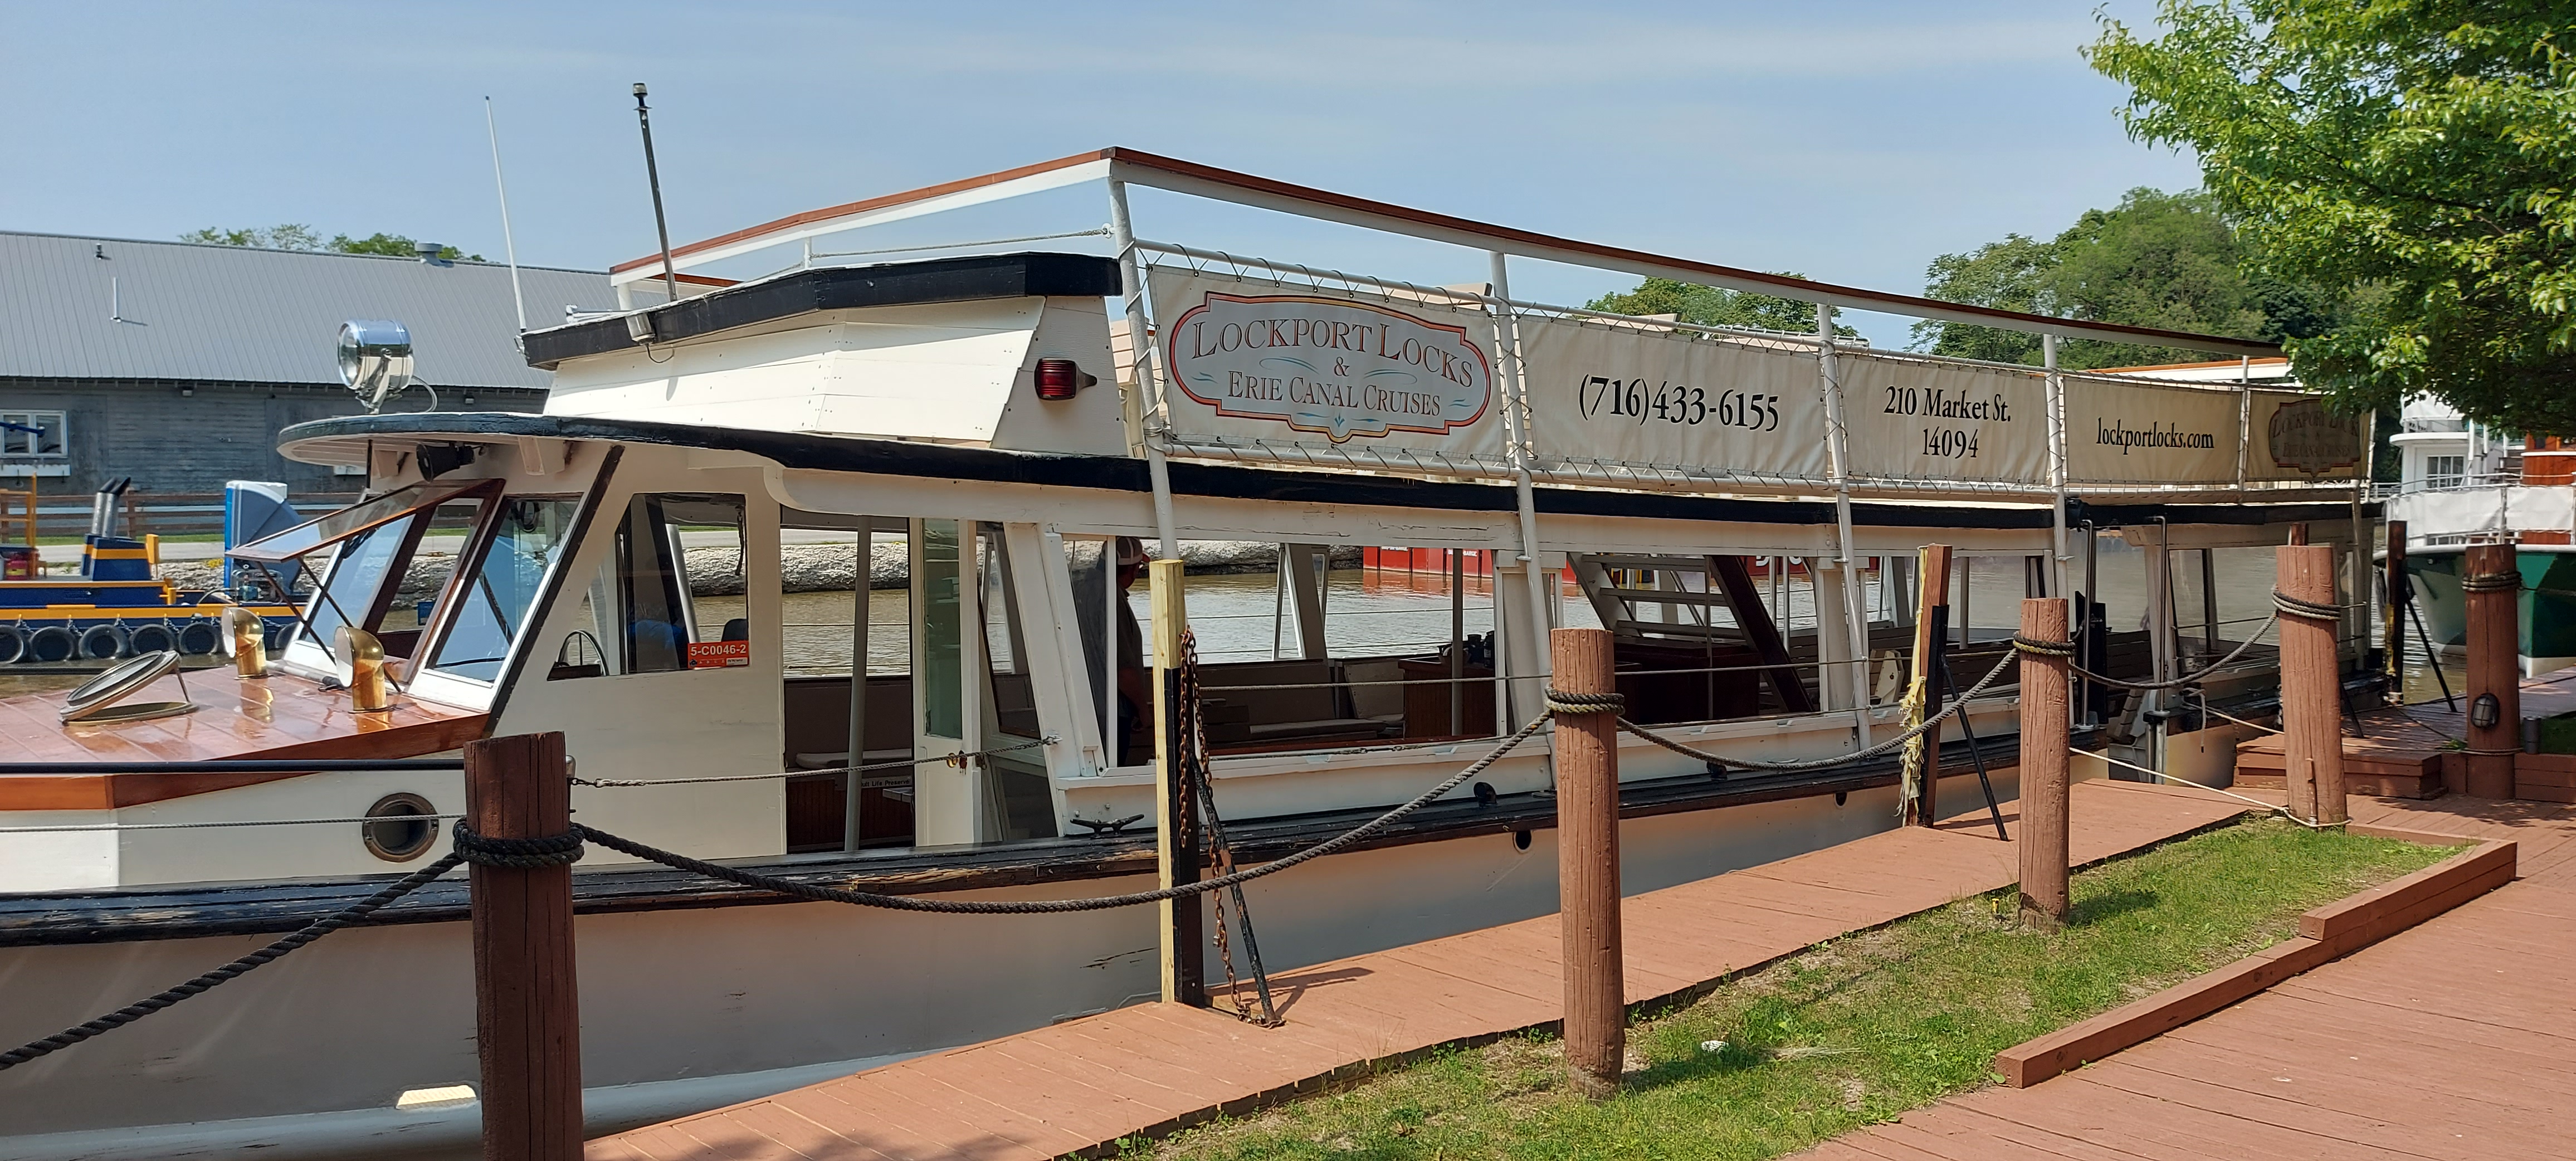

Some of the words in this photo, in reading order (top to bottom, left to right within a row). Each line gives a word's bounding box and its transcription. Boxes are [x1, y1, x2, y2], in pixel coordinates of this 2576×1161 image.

[1192, 318, 1372, 359] LOCKPORT
[1378, 323, 1473, 388] LOCKS
[1334, 357, 1350, 377] &
[1228, 370, 1283, 402] ERIE
[1289, 376, 1359, 409] CANAL
[1363, 384, 1441, 416] CRUISES
[1579, 374, 1779, 432] (716)433-6155
[1884, 386, 1918, 416] 210
[1922, 388, 1989, 421] Market
[1993, 393, 2011, 422] St.
[1923, 426, 1979, 459] 14094
[2096, 417, 2215, 455] lockportlocks.com
[690, 644, 747, 656] 5-C0046-2
